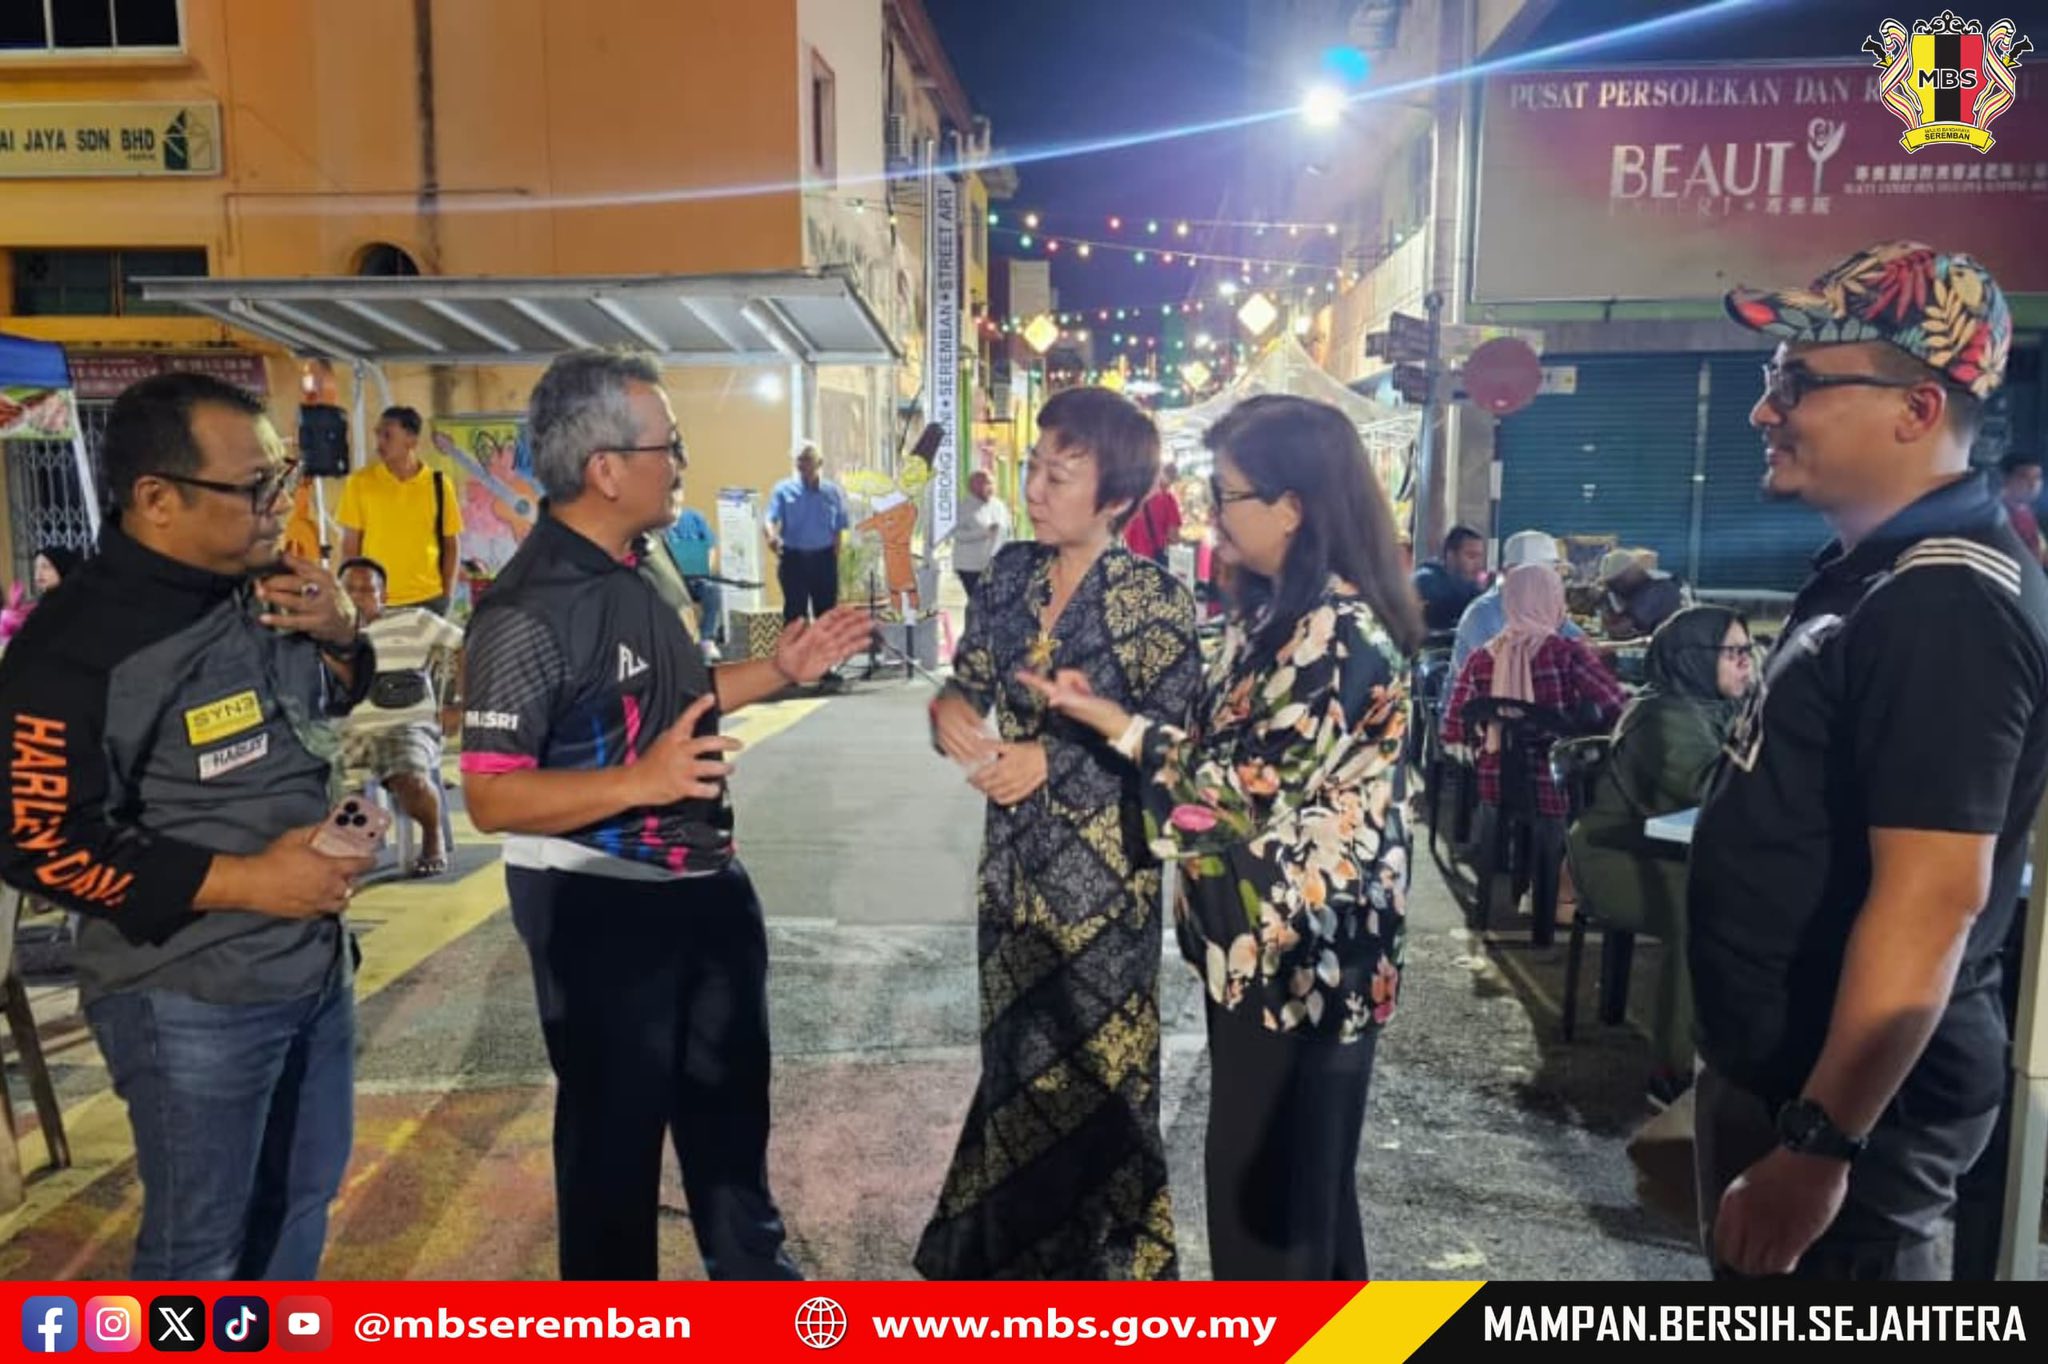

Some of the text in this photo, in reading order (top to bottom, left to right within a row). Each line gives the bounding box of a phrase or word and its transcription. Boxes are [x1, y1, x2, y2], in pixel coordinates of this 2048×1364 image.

[1510, 81, 1588, 109] PUSAT
[1599, 75, 1782, 108] PERSOLEKAN
[1794, 74, 1850, 104] DAN
[24, 129, 67, 152] JAYA
[77, 128, 110, 151] SDN
[121, 128, 155, 151] BHD
[938, 188, 954, 221] ART
[938, 226, 953, 290] STREET
[938, 304, 953, 396] SEREMBAN
[938, 452, 953, 522] LORONG
